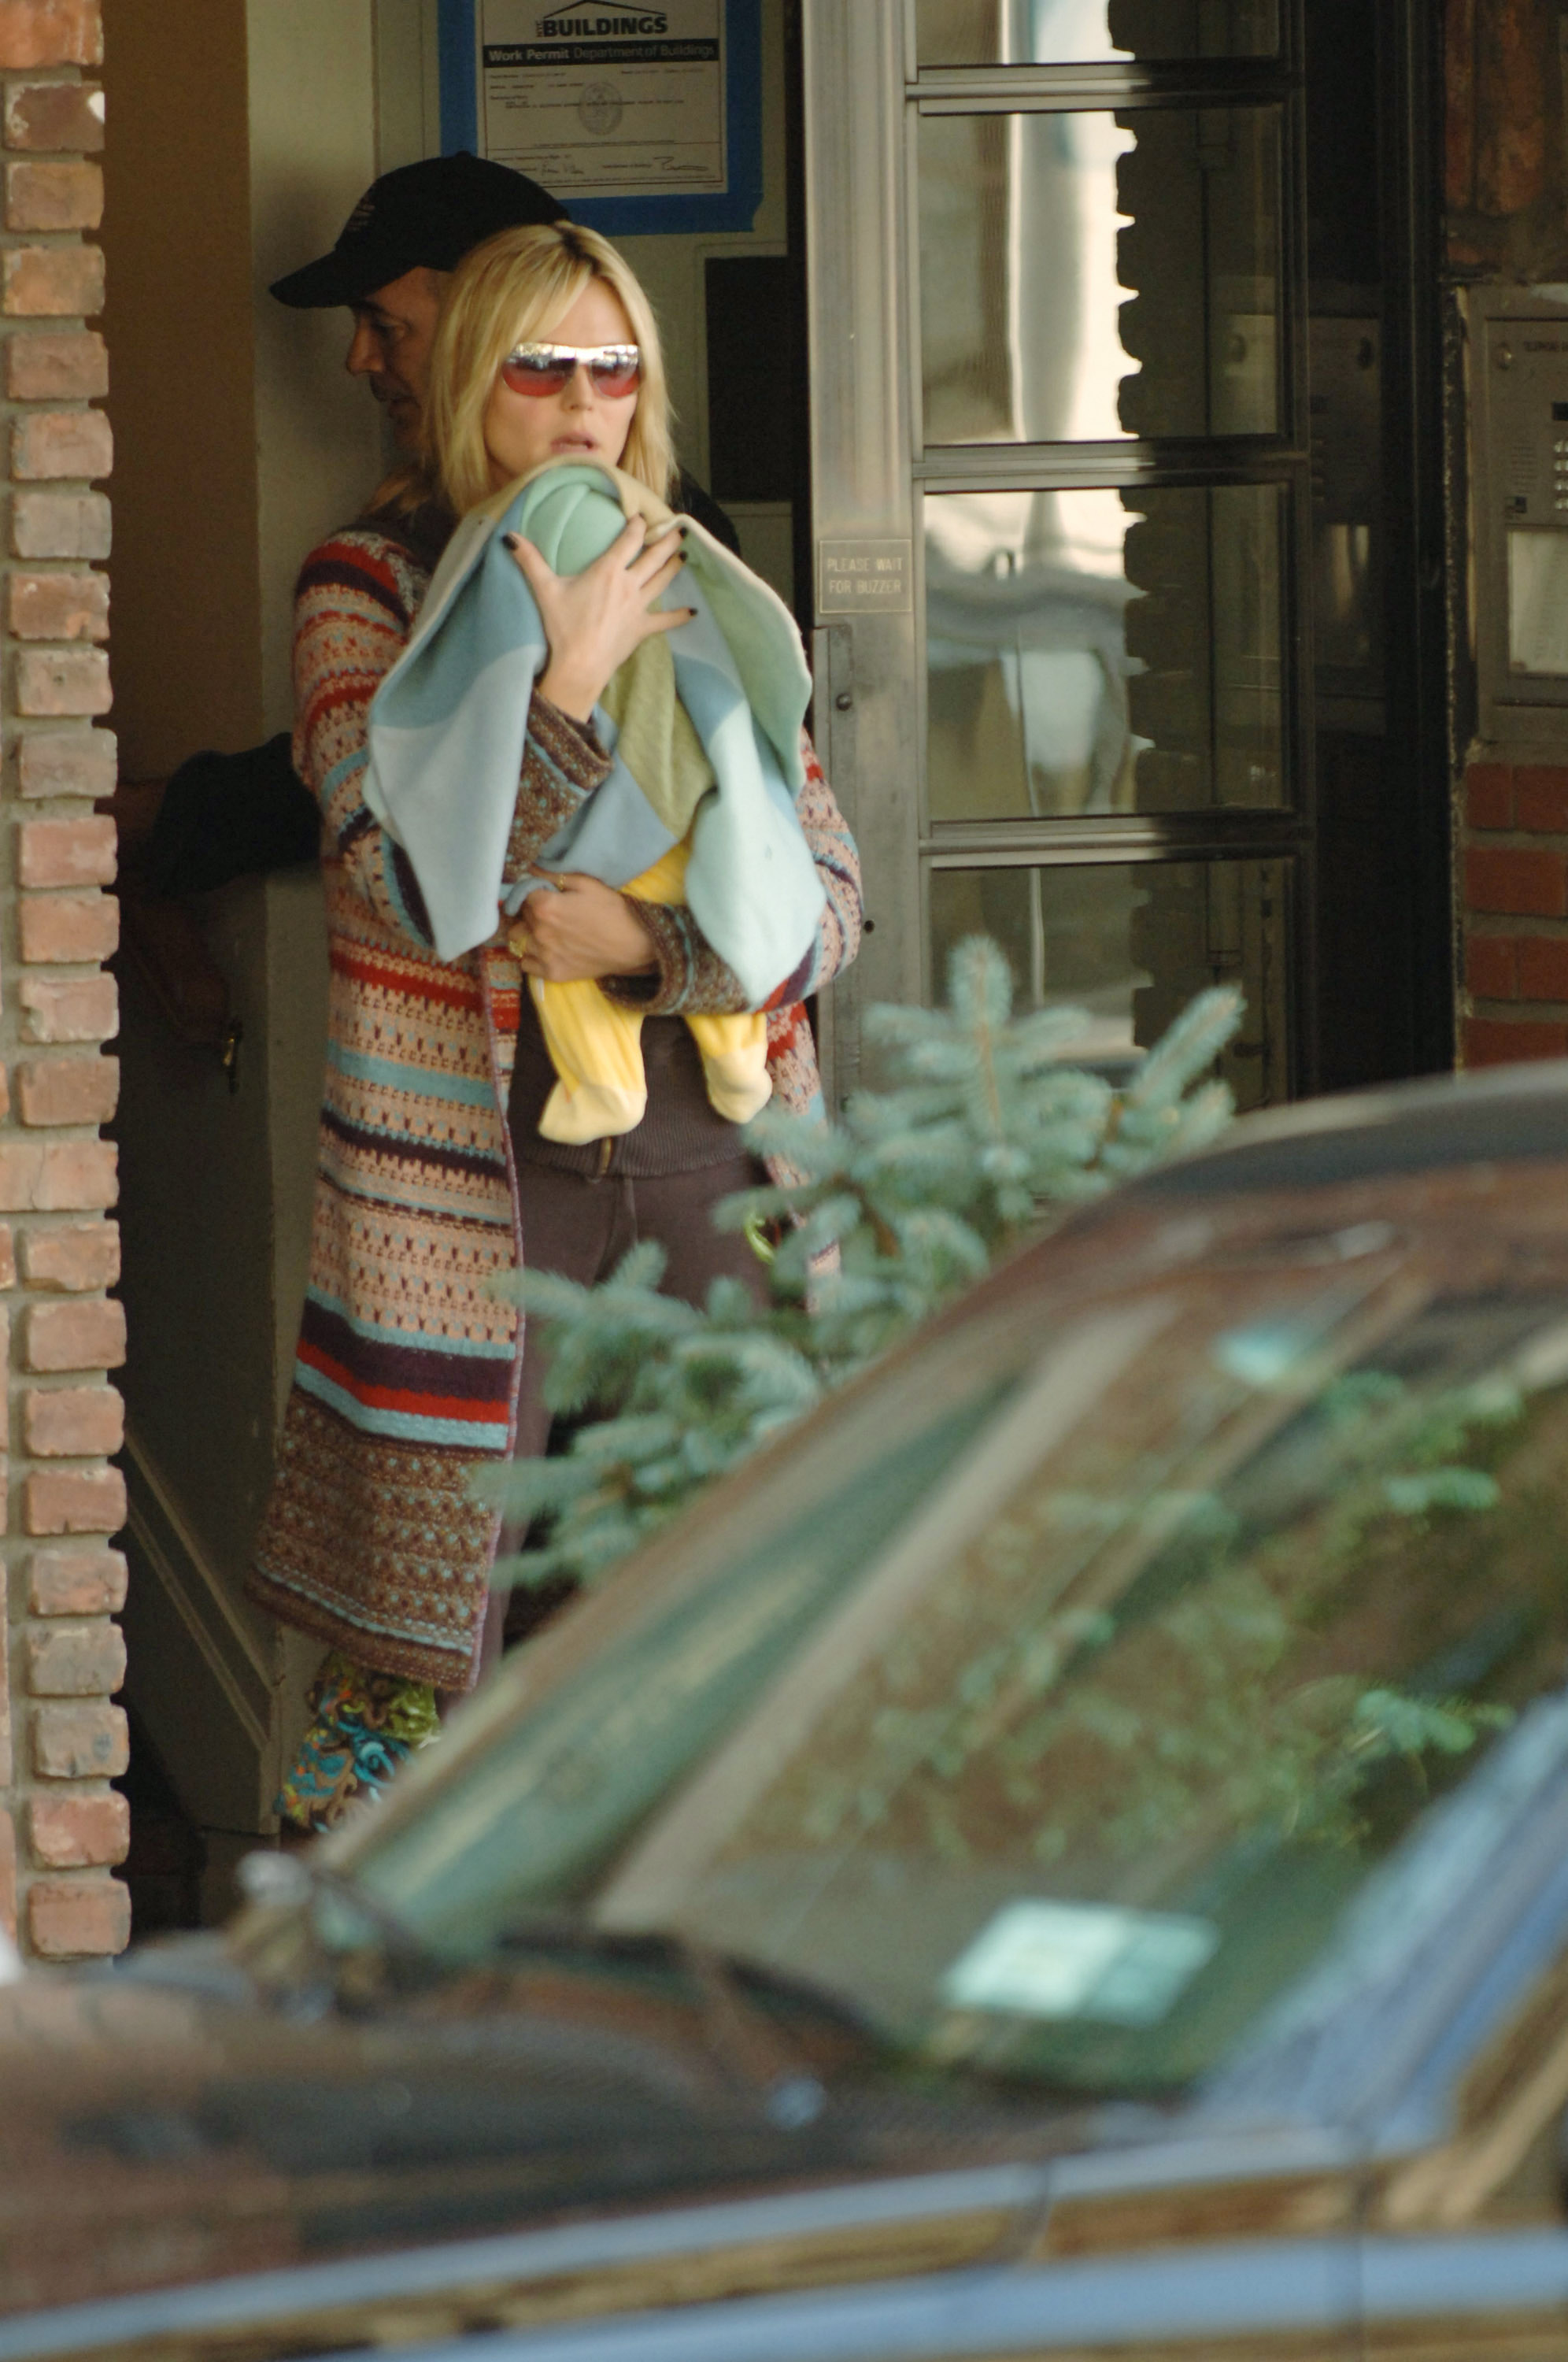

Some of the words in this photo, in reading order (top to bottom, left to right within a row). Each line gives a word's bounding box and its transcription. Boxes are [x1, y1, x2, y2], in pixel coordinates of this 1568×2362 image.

[543, 17, 668, 37] BUILDINGS
[489, 50, 523, 61] Work
[527, 49, 569, 61] Permit
[573, 46, 643, 60] Department
[644, 45, 657, 57] of
[660, 44, 715, 58] Buildings
[827, 557, 870, 572] PLEASE
[876, 557, 903, 571] WAIT
[830, 579, 852, 594] FOR
[856, 579, 901, 594] BUZZER
